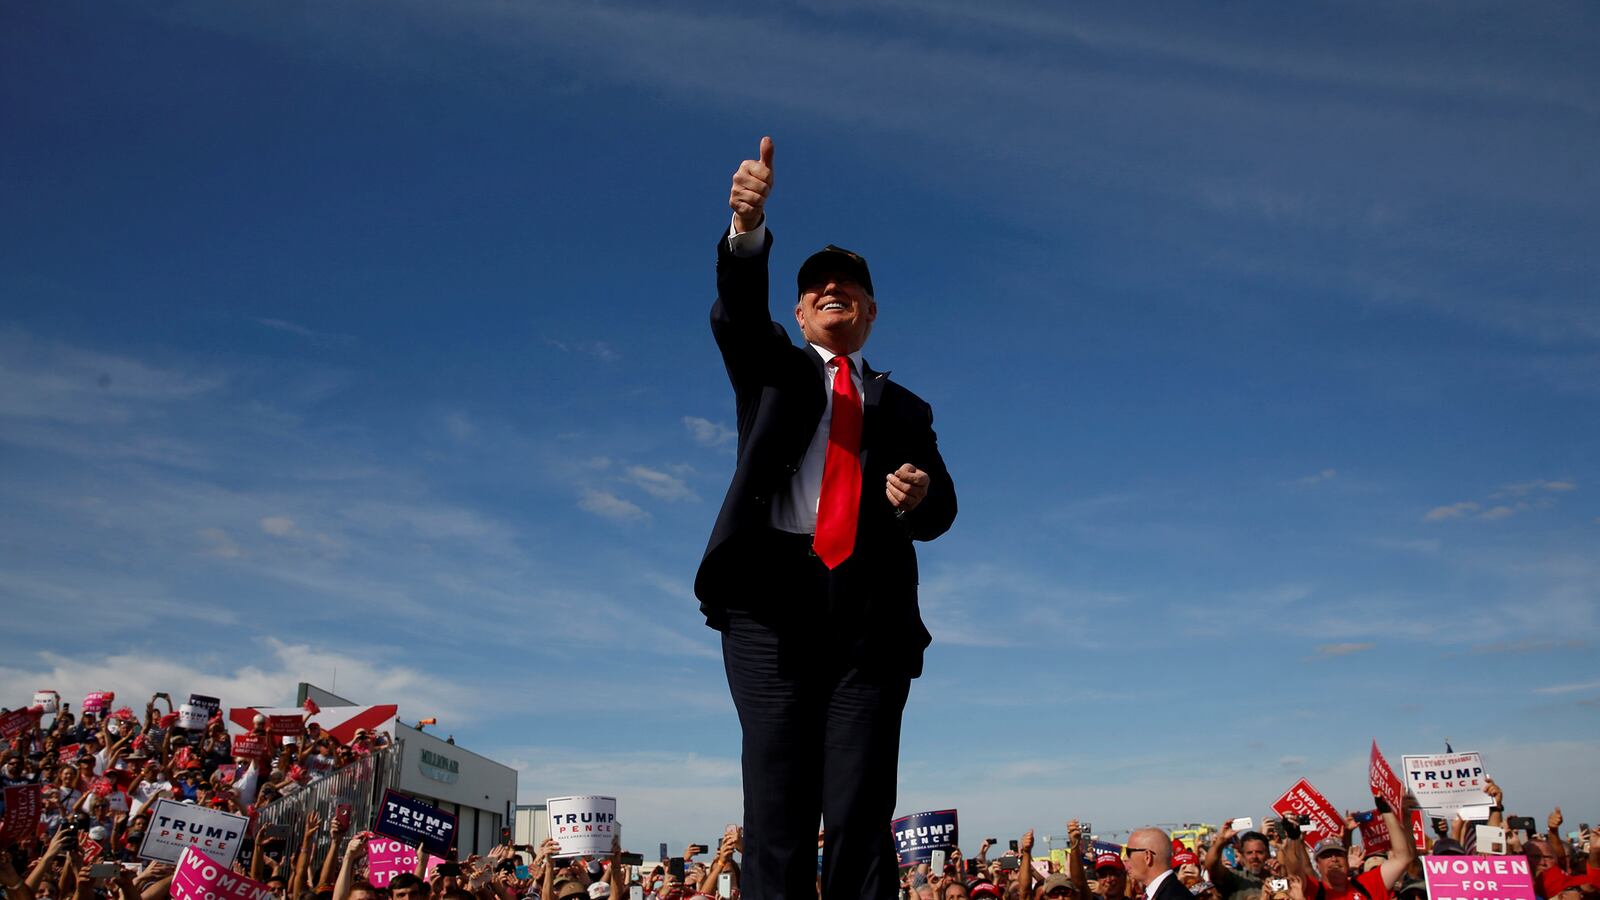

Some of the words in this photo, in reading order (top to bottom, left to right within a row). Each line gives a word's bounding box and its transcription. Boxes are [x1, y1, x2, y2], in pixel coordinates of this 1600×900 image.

[191, 699, 219, 707] TRUMP
[180, 711, 207, 719] TRUMP
[1410, 767, 1482, 780] TRUMP
[1418, 779, 1479, 789] PENCE
[1297, 788, 1320, 811] AGAIN
[387, 801, 453, 830] TRUMP
[553, 812, 614, 825] TRUMP
[1317, 810, 1339, 832] GREAT
[159, 816, 238, 841] TRUMP
[390, 813, 445, 837] PENCE
[399, 823, 417, 831] AMERICA
[559, 824, 612, 834] PENCE
[896, 824, 954, 841] TRUMP
[160, 830, 227, 849] PENCE
[901, 835, 950, 848] PENCE
[370, 841, 416, 854] WOM
[1427, 860, 1529, 875] WOMEN
[187, 850, 267, 899] WOMEN
[1462, 880, 1499, 891] FOR
